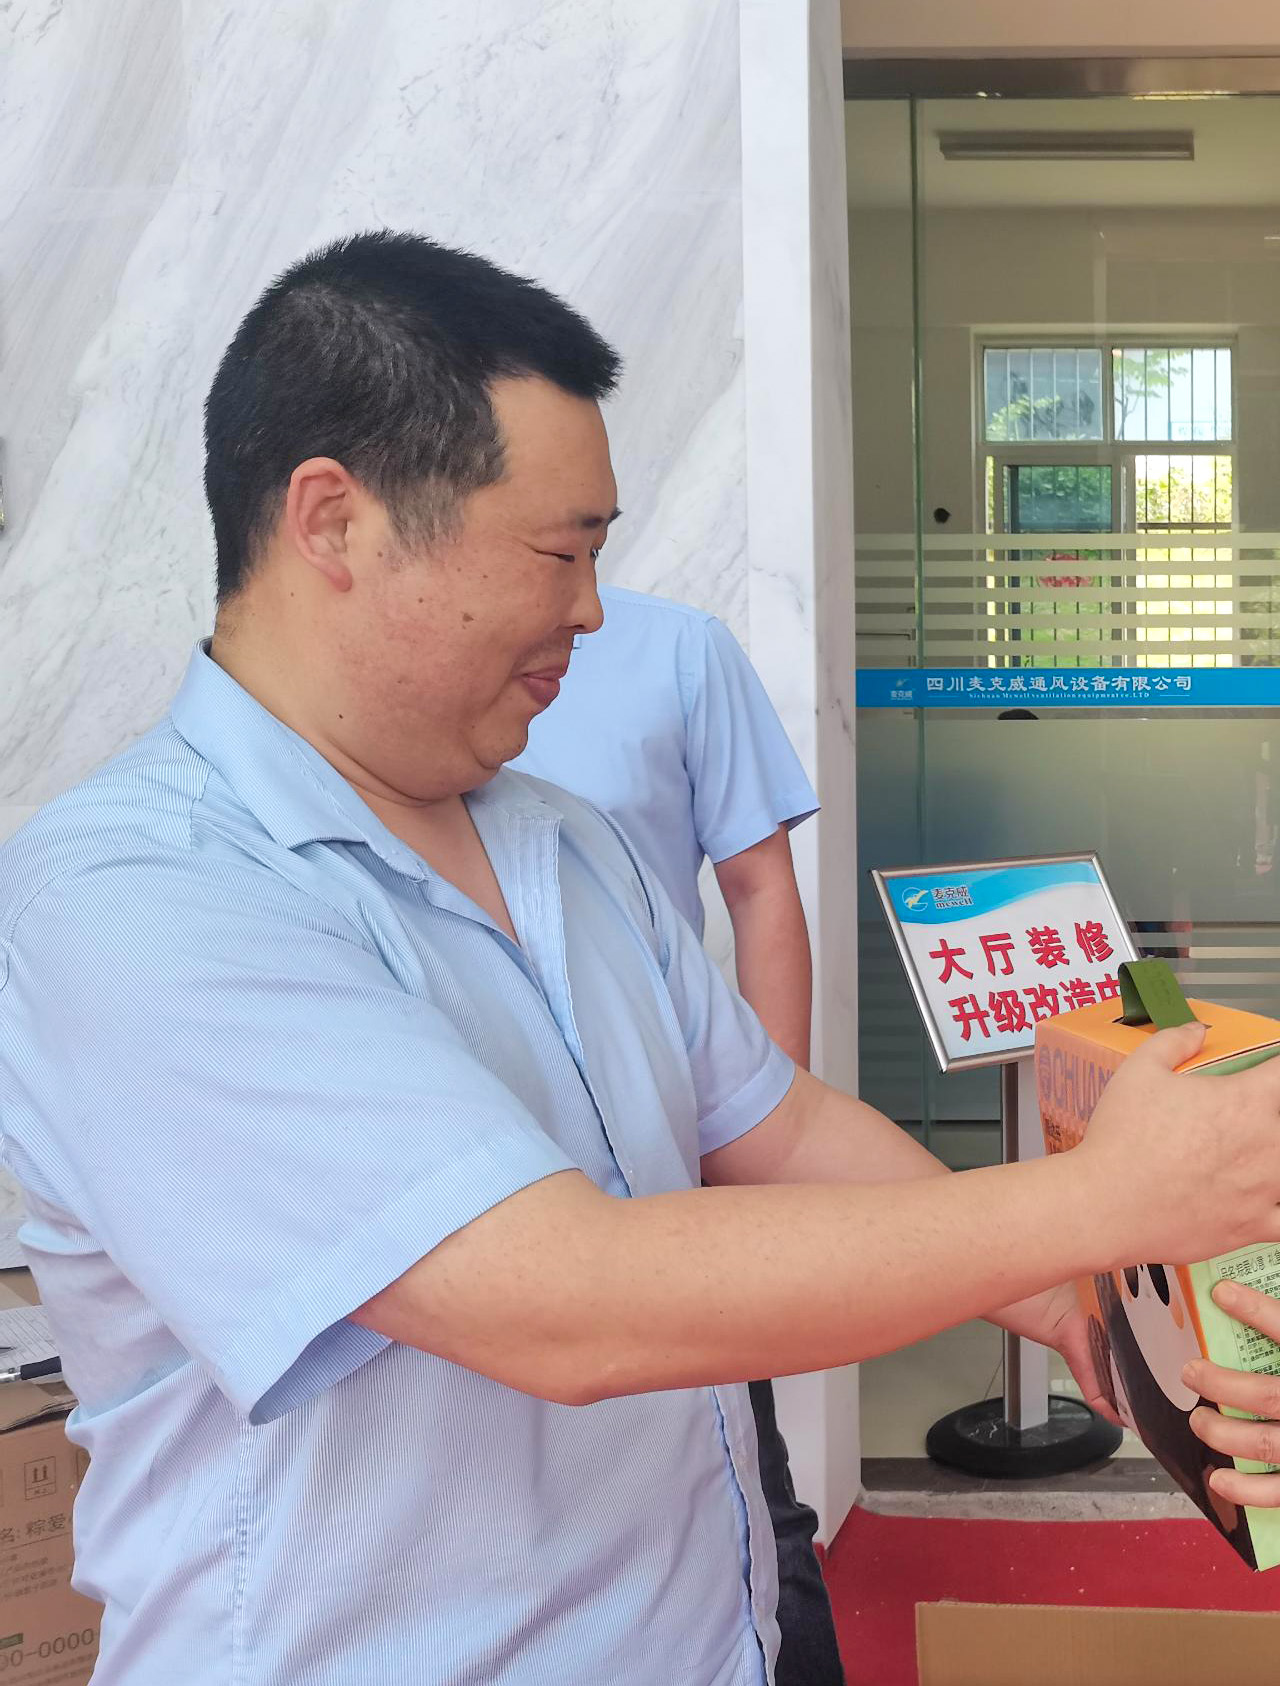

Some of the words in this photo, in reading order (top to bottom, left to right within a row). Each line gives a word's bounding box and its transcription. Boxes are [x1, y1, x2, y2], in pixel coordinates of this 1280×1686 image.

[927, 676, 1192, 691] 四川麦克威通风设备有限公司
[931, 886, 968, 899] 麦克威
[929, 920, 1115, 984] 大厅装修
